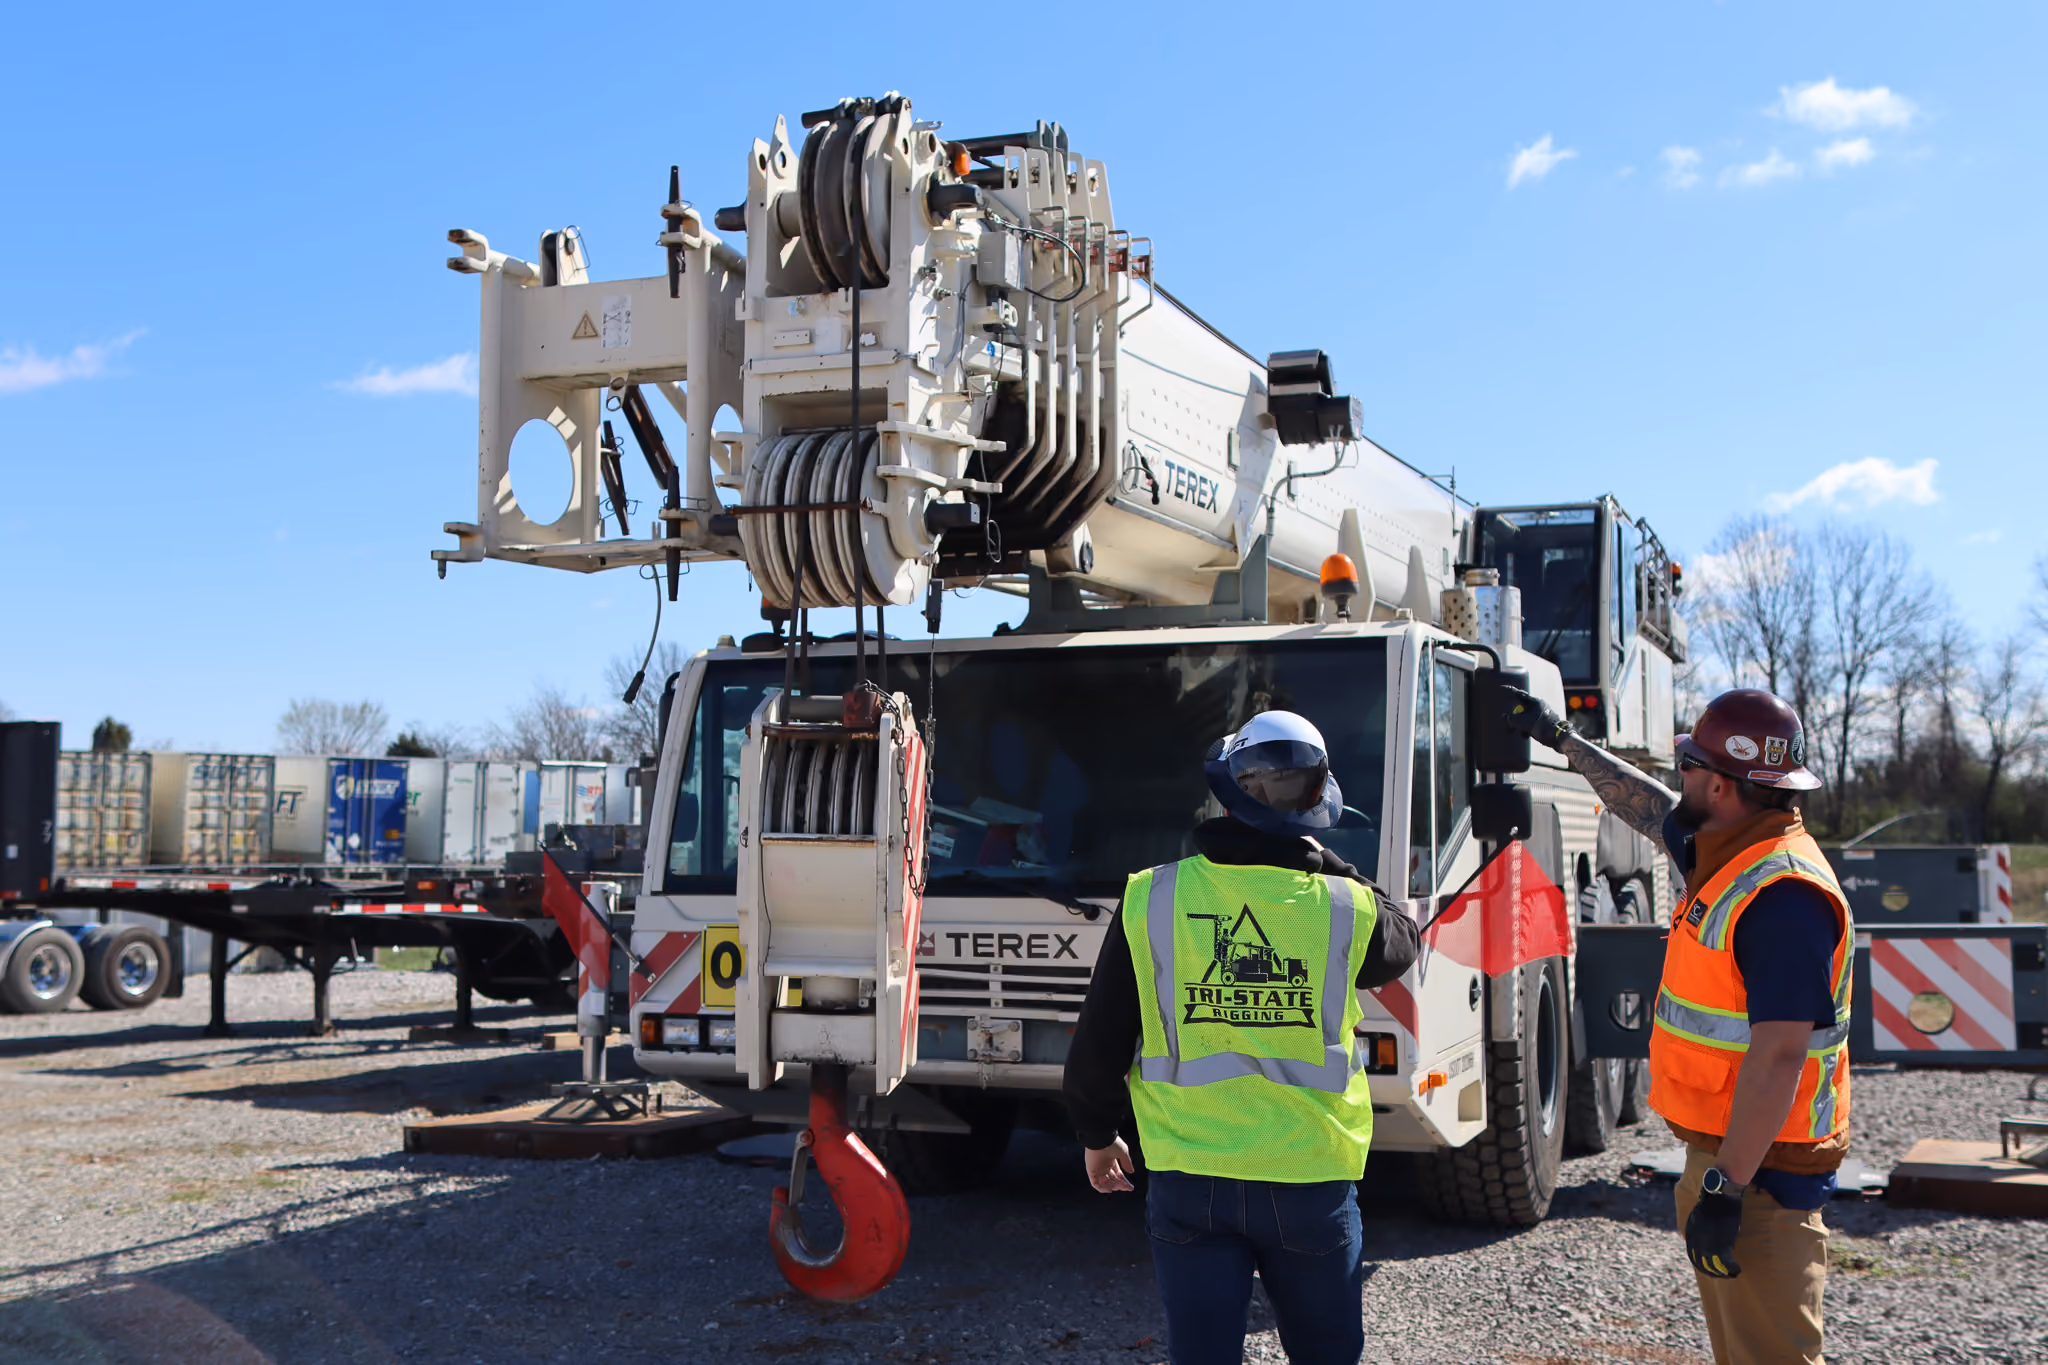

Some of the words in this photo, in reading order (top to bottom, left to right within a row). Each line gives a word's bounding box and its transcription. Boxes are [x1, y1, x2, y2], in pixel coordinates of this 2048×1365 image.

[1165, 460, 1219, 513] TEREX
[946, 932, 1079, 959] TEREX
[1185, 987, 1313, 1007] TRI-STATE
[1212, 1008, 1284, 1020] RIGGING
